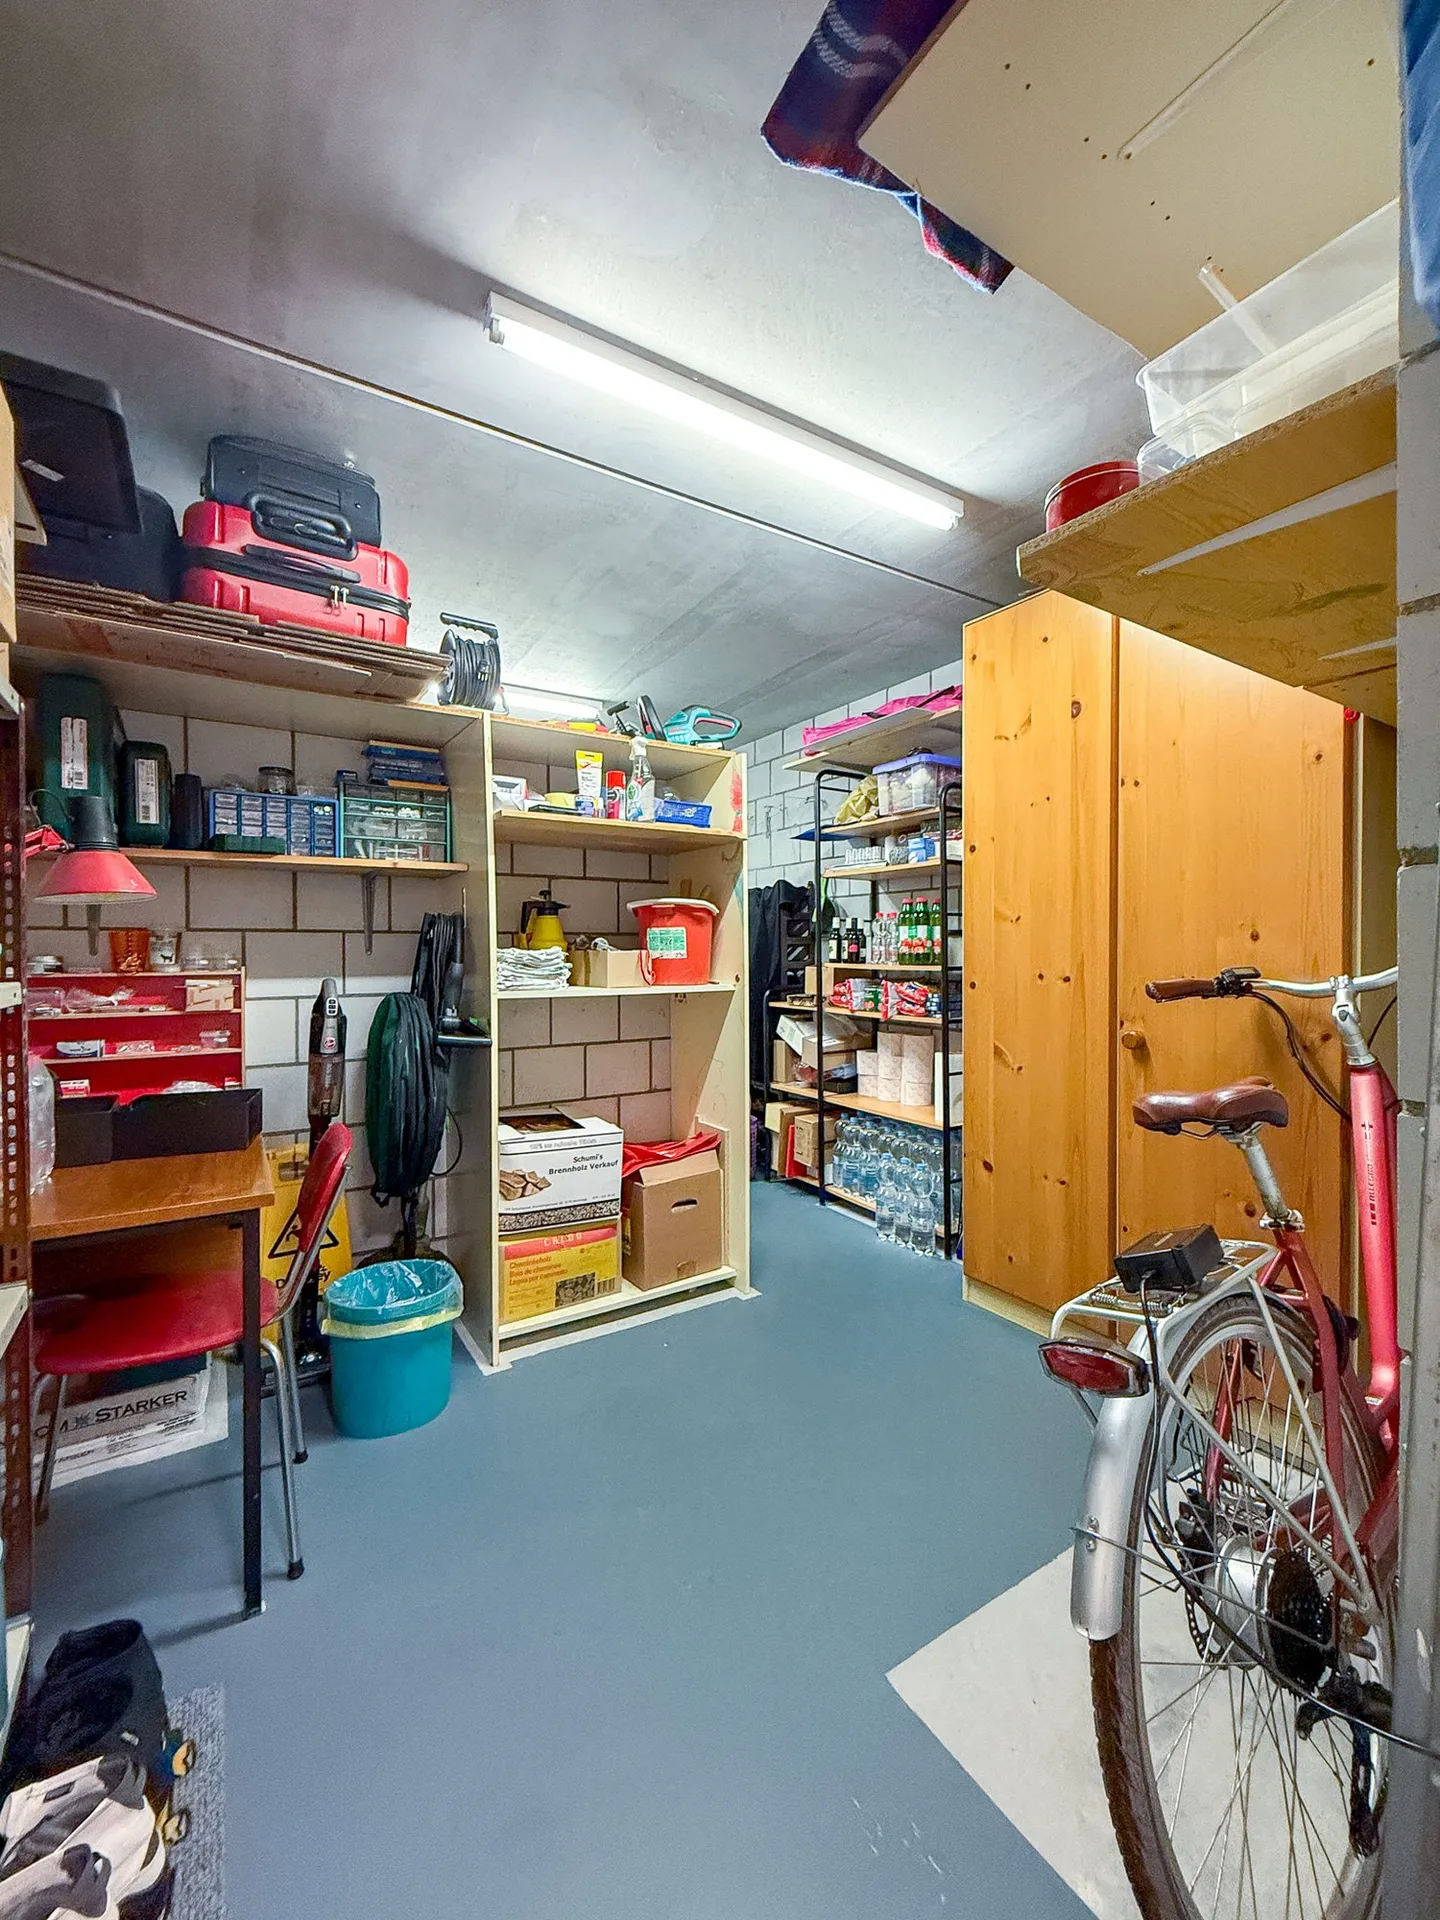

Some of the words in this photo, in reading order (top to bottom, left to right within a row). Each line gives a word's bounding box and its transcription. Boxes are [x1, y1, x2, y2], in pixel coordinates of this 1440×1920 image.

[573, 1153, 603, 1163] Schumi's
[549, 1164, 588, 1175] Brennholz
[590, 1160, 619, 1170] Verkauf
[95, 1390, 188, 1422] STARKER
